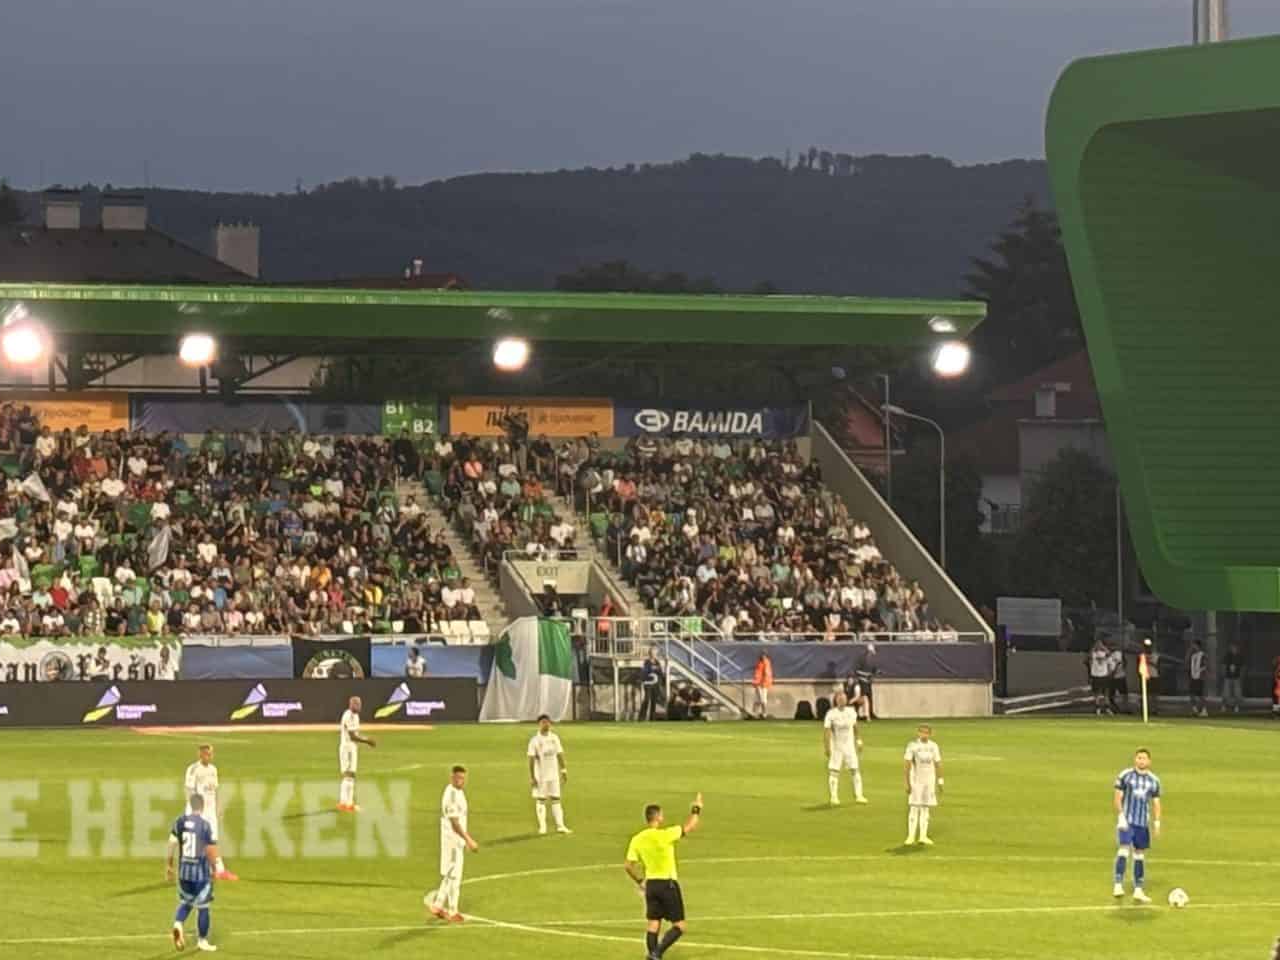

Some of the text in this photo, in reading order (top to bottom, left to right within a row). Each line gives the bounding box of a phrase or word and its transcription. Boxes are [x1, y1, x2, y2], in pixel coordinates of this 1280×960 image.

[413, 419, 433, 433] B2
[672, 411, 762, 434] BAMIDA
[536, 566, 558, 577] EXIT
[182, 831, 197, 858] 21
